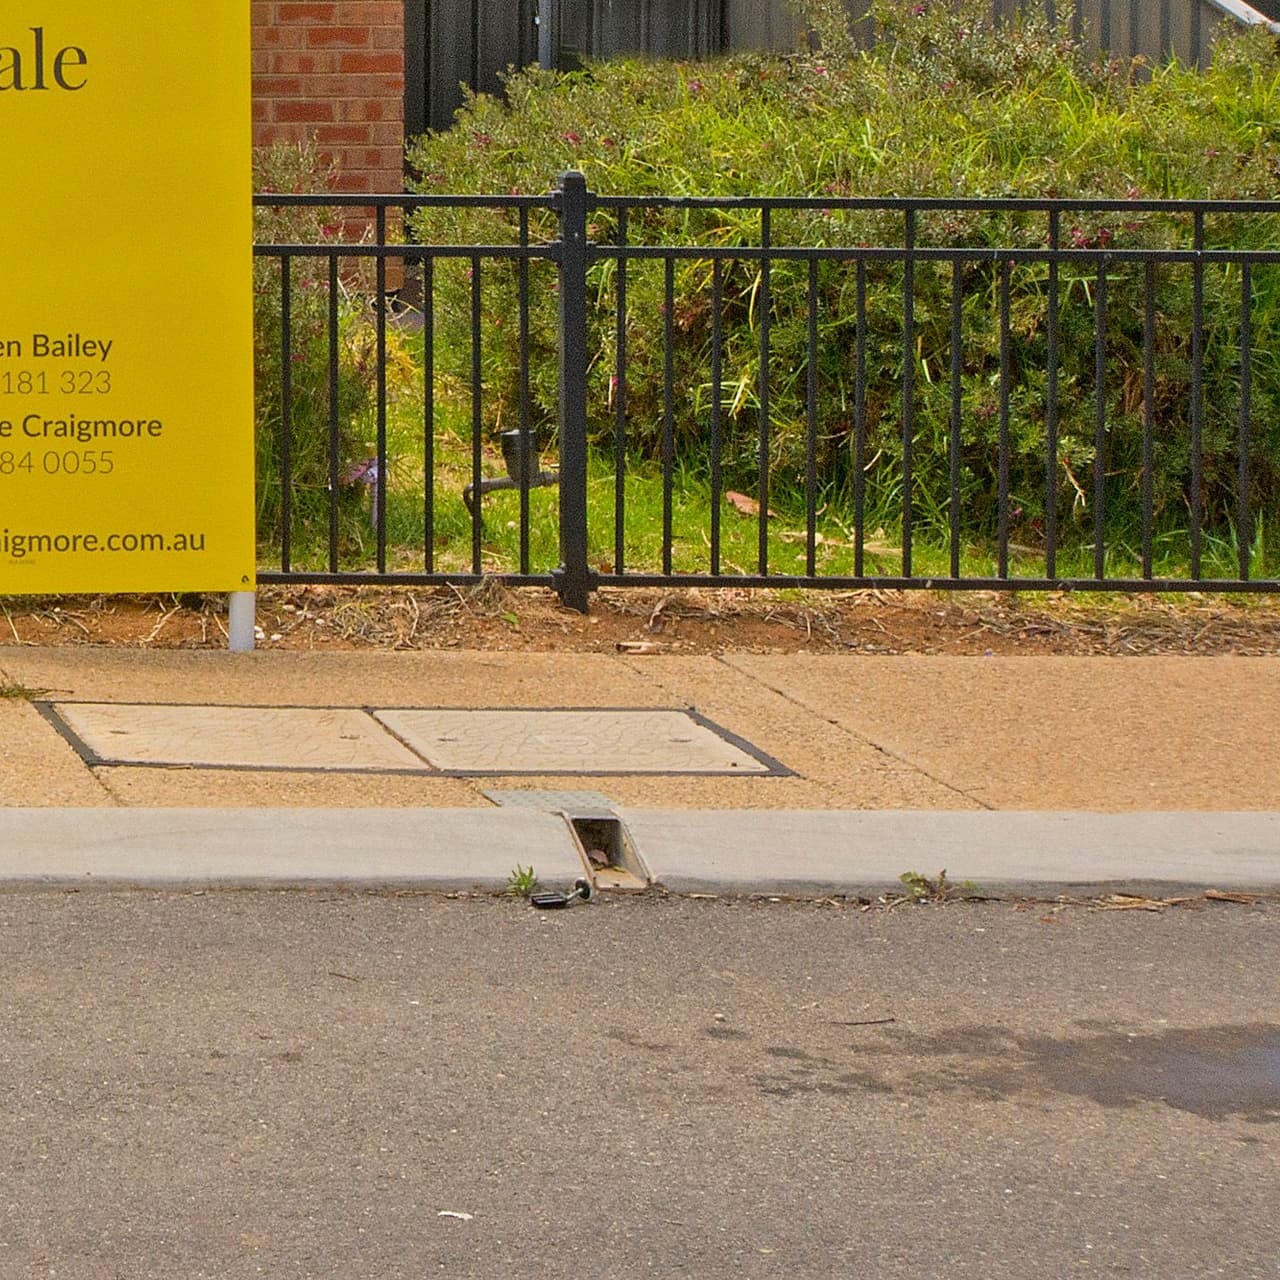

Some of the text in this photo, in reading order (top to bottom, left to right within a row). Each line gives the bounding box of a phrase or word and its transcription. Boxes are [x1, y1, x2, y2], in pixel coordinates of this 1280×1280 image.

[32, 333, 113, 362] Bailey
[2, 370, 50, 395] 181
[60, 370, 112, 395] 323
[22, 413, 163, 442] Craigmore
[42, 450, 114, 475] 0055
